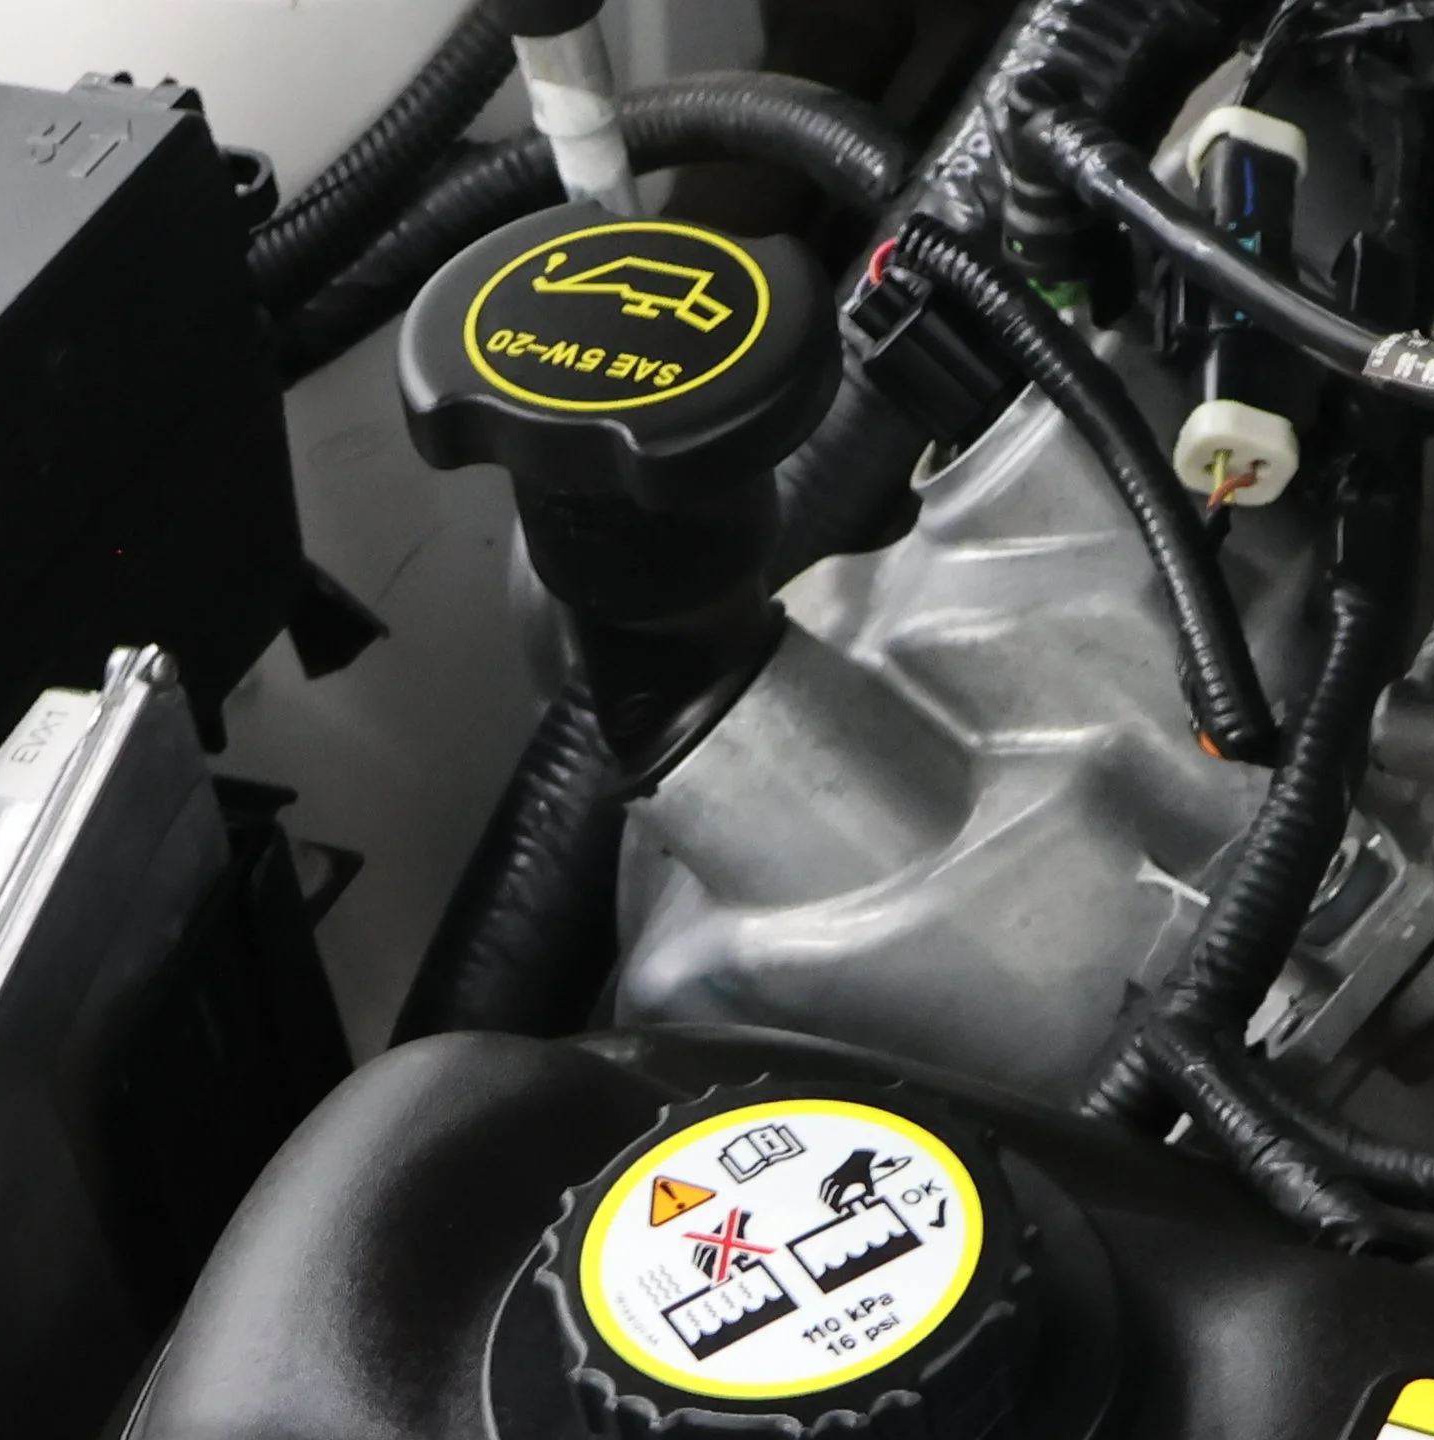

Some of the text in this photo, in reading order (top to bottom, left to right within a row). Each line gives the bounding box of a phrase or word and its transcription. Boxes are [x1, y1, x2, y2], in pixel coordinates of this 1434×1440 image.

[486, 328, 683, 388] SAE 5W-20
[902, 1179, 944, 1205] OK
[802, 1292, 895, 1344] 110 kPa
[826, 1311, 901, 1356] 16 psi
